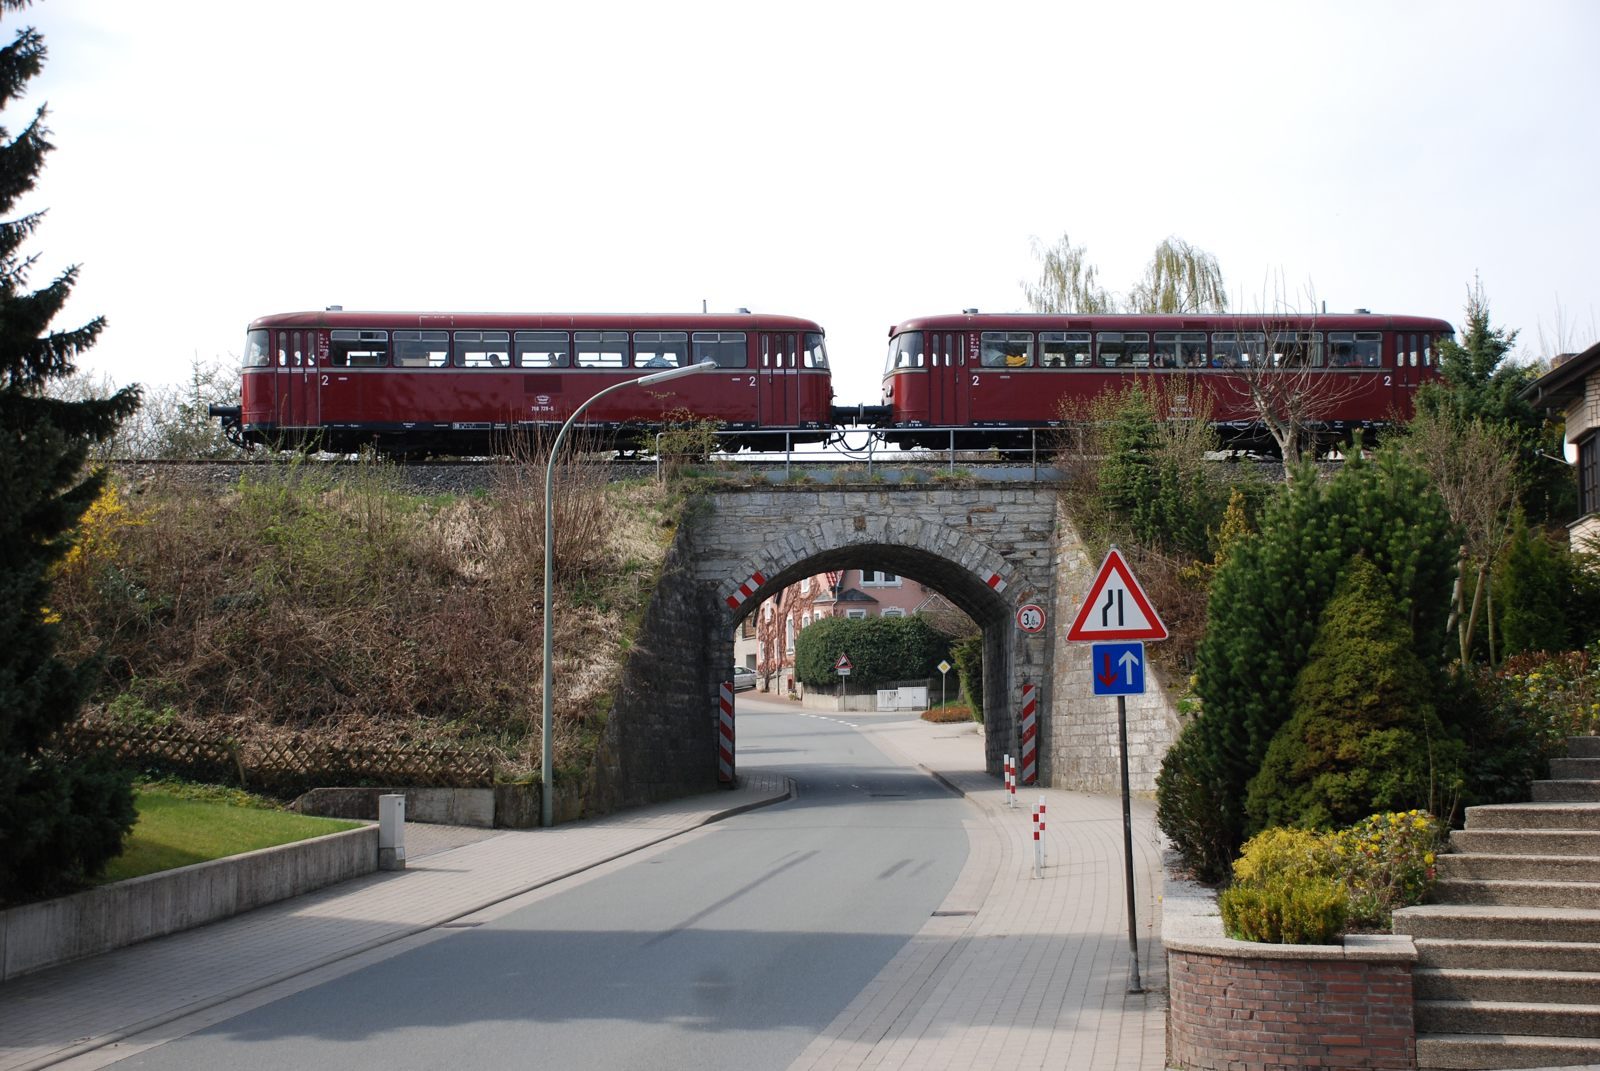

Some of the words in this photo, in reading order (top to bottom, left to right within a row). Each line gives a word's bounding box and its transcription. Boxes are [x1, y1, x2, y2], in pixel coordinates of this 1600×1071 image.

[321, 375, 329, 386] 2
[749, 376, 756, 387] 2
[972, 375, 980, 386] 2
[1384, 375, 1391, 386] 2
